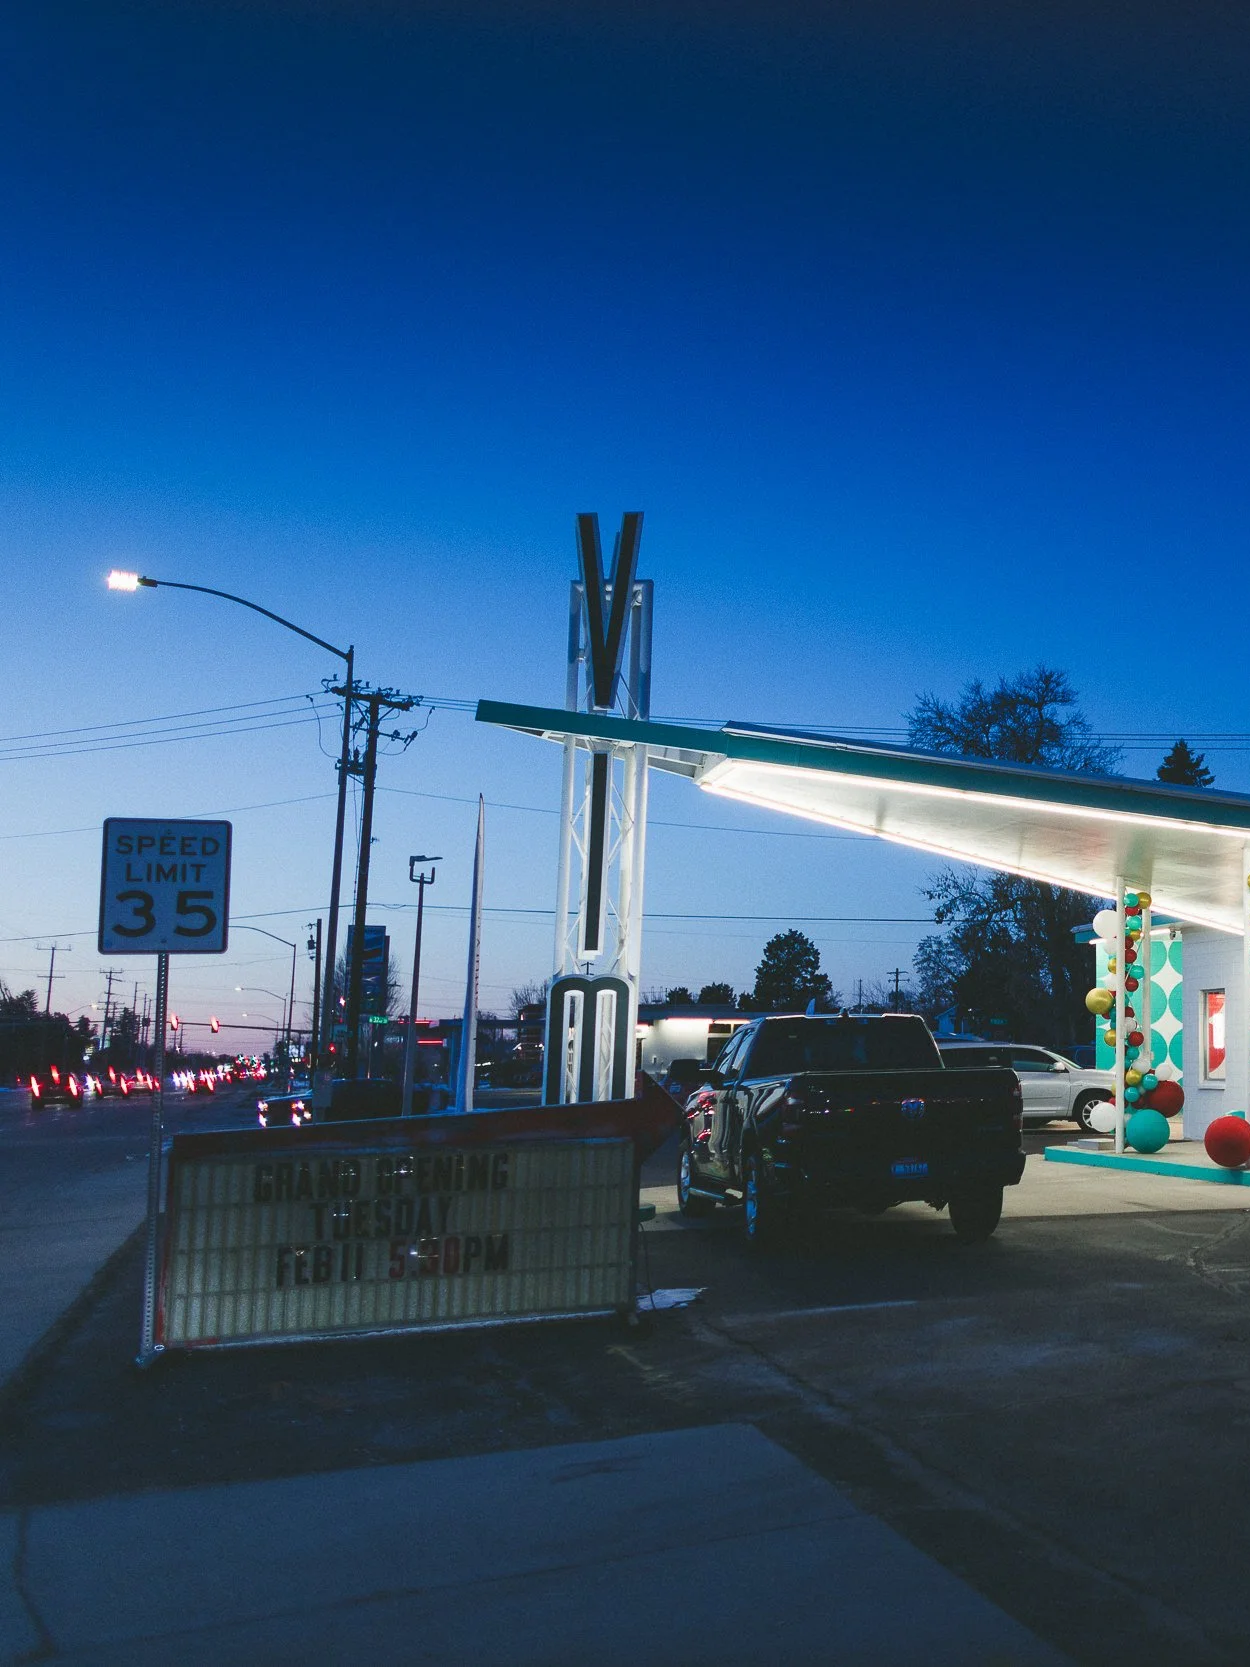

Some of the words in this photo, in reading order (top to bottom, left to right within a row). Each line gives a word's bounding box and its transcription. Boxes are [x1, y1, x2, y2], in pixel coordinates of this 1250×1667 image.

[116, 835, 220, 856] SPEED
[125, 863, 206, 883] LIMIT
[112, 890, 217, 938] 35
[254, 1158, 361, 1202] GRAND
[376, 1152, 509, 1196] OPENING
[310, 1196, 453, 1239] TUESDAY
